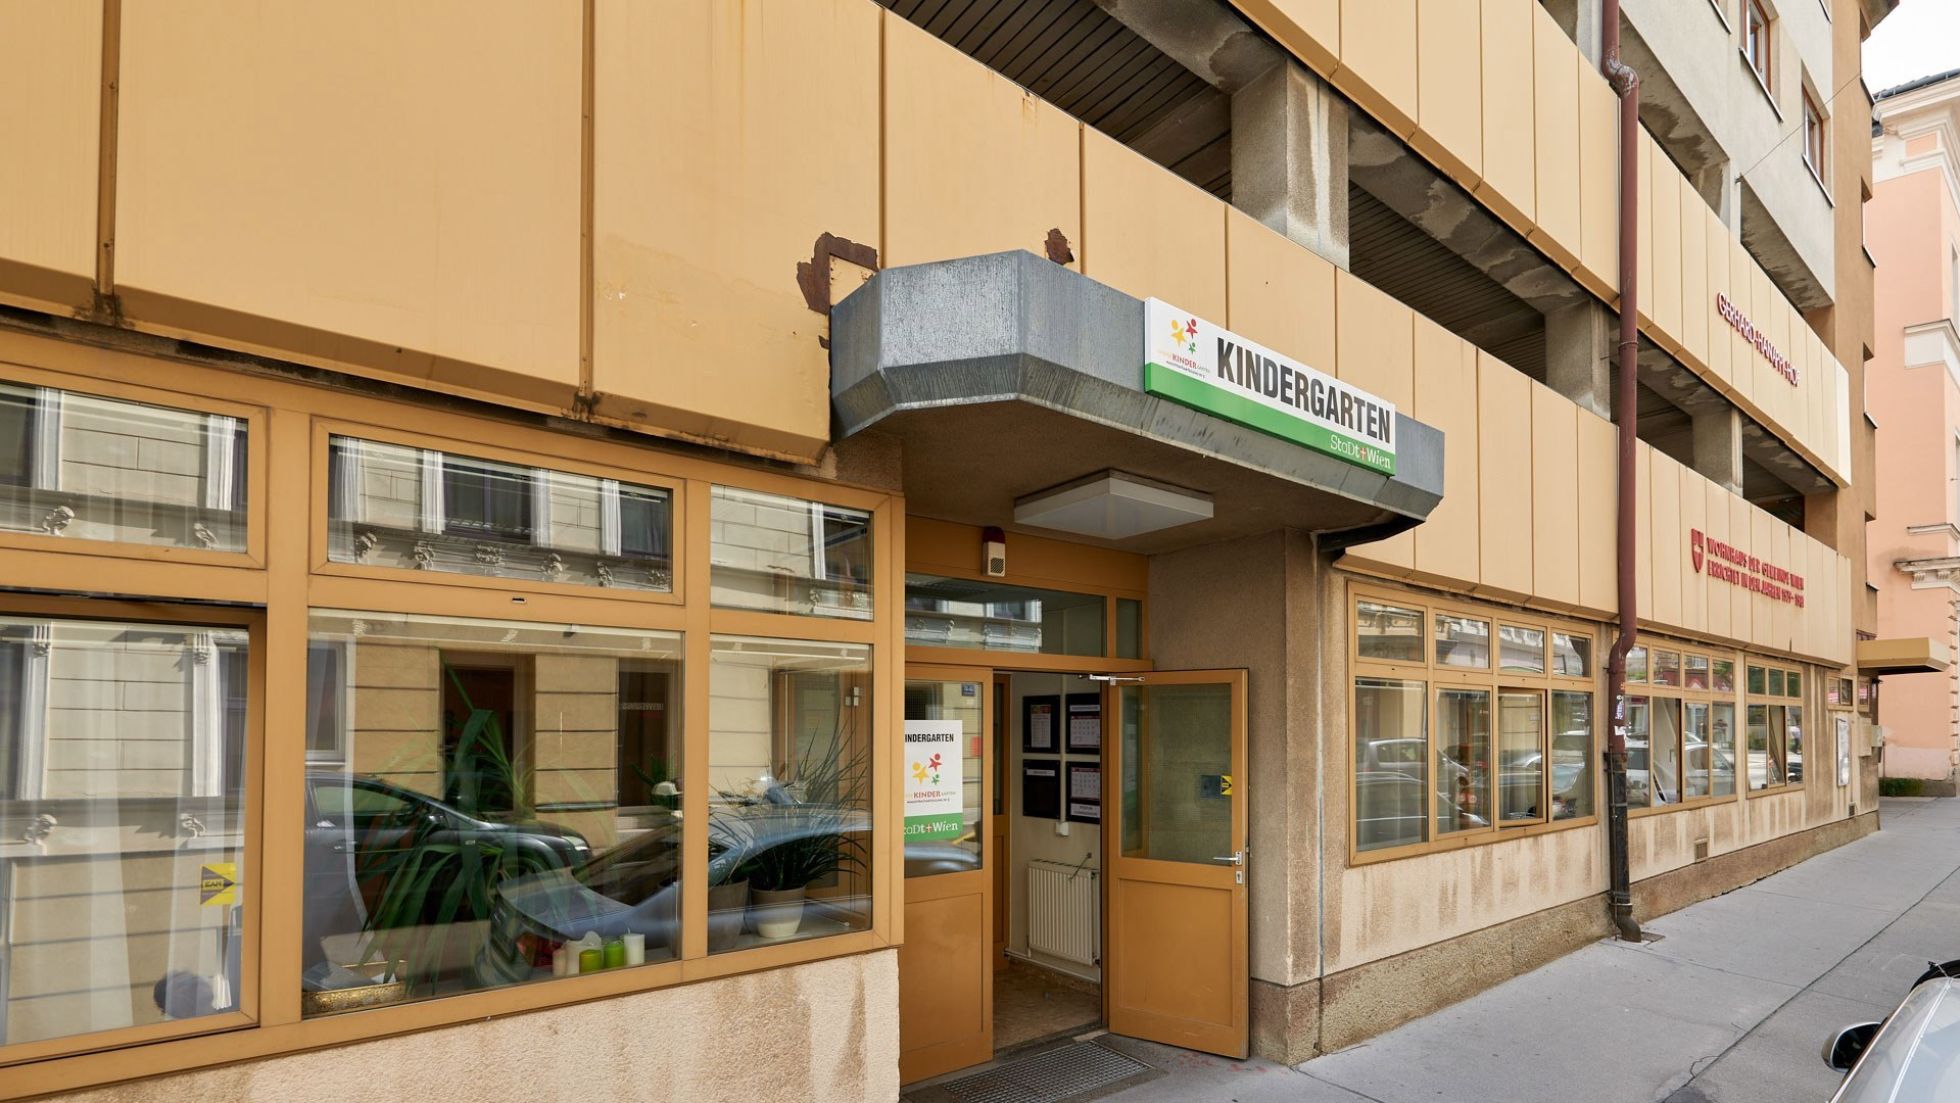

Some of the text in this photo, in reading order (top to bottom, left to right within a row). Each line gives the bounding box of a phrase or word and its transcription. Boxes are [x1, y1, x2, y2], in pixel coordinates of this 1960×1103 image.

[1217, 337, 1391, 444] KINDERGARTEN
[1706, 537, 1747, 568] WOHNHAUS
[905, 733, 954, 743] INDERGARTEN
